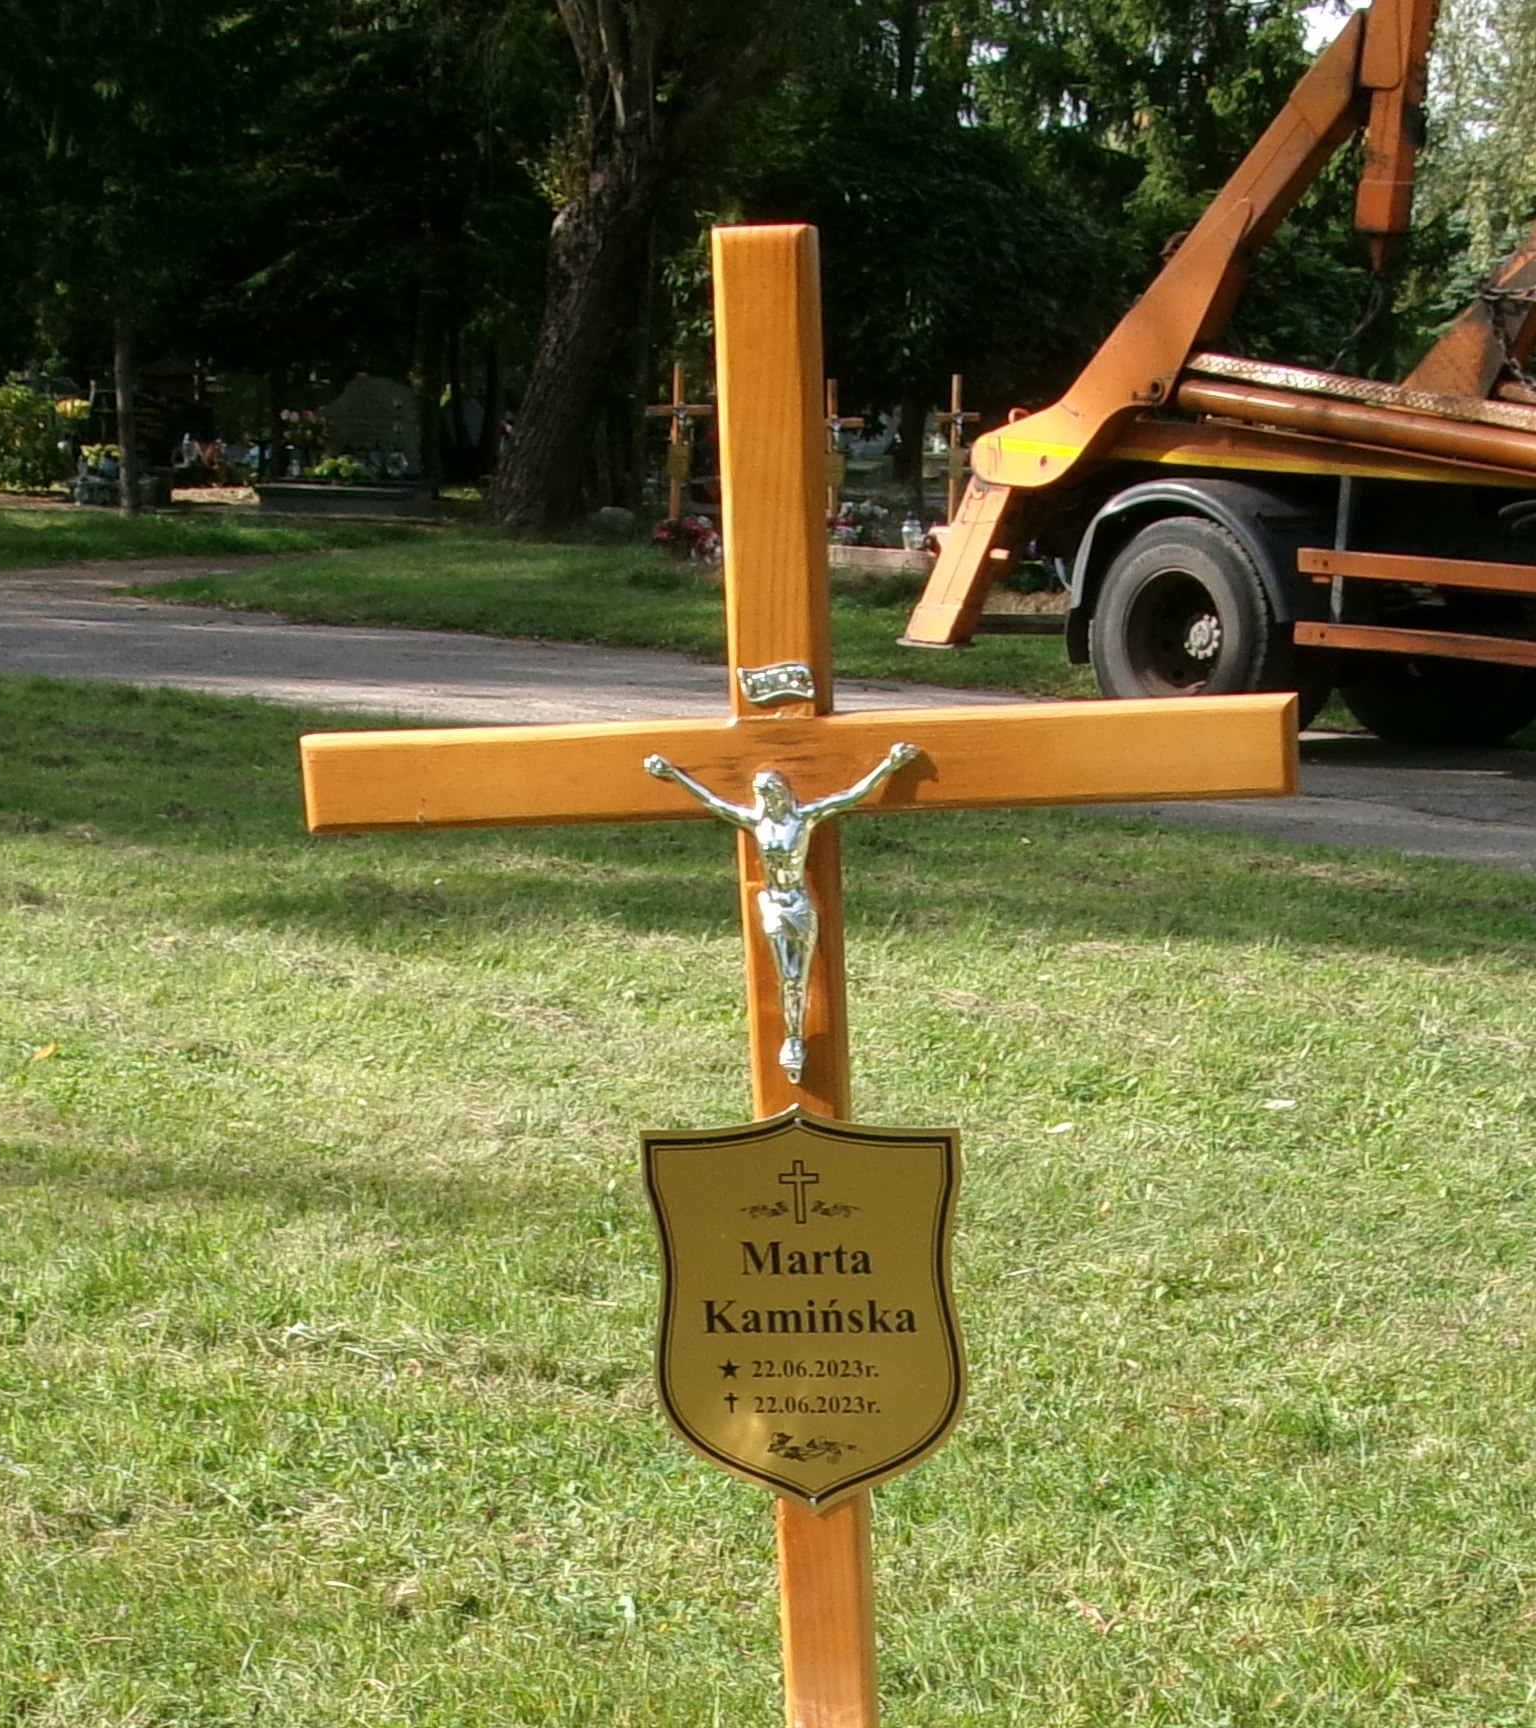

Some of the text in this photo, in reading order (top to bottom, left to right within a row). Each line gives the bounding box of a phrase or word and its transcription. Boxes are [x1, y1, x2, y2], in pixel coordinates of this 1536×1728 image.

[740, 1241, 872, 1275] Marta
[703, 1299, 916, 1333] Kamińska
[751, 1360, 880, 1378] 22.06.2023r.
[754, 1396, 881, 1414] 22.06.2023r.
